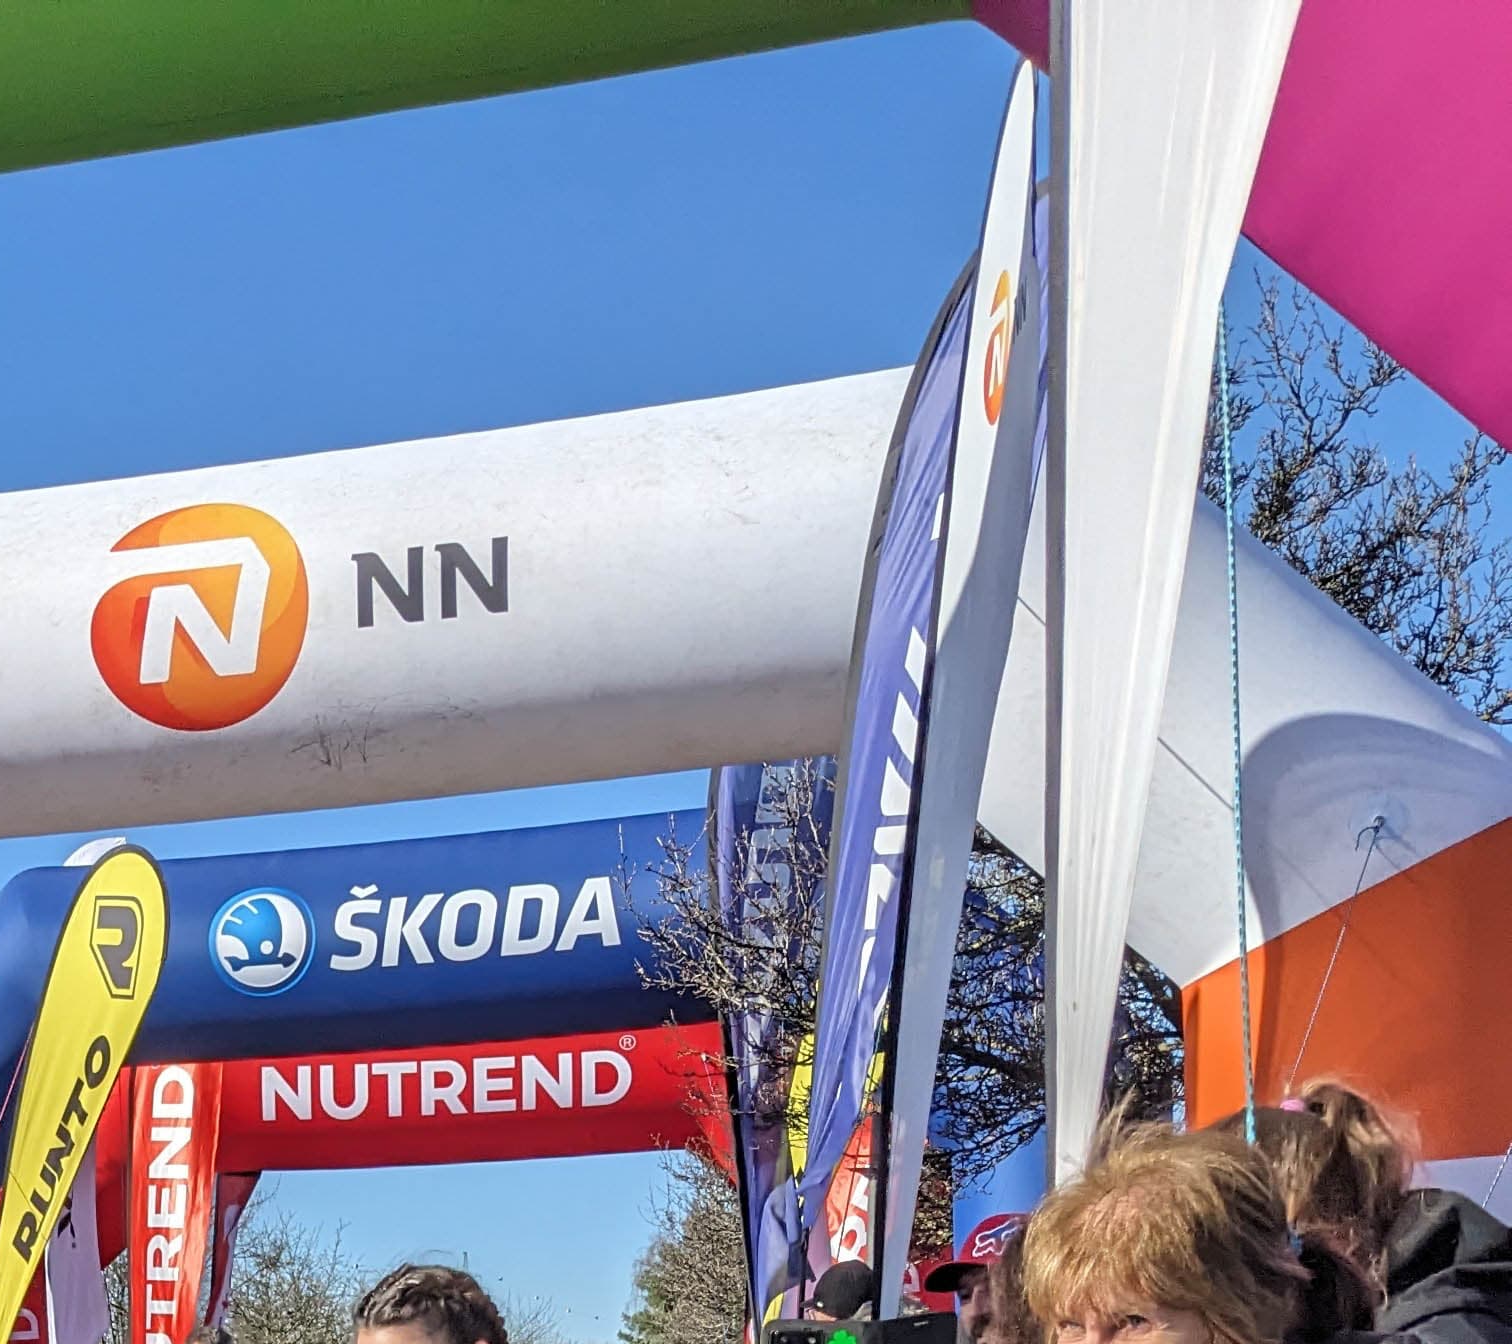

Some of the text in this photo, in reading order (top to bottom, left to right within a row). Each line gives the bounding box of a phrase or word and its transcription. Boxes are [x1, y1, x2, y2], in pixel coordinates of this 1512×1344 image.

[351, 536, 510, 628] NN
[330, 876, 622, 970] ŠKODA
[262, 1049, 634, 1122] NUTREND
[12, 1035, 111, 1264] RUNTO
